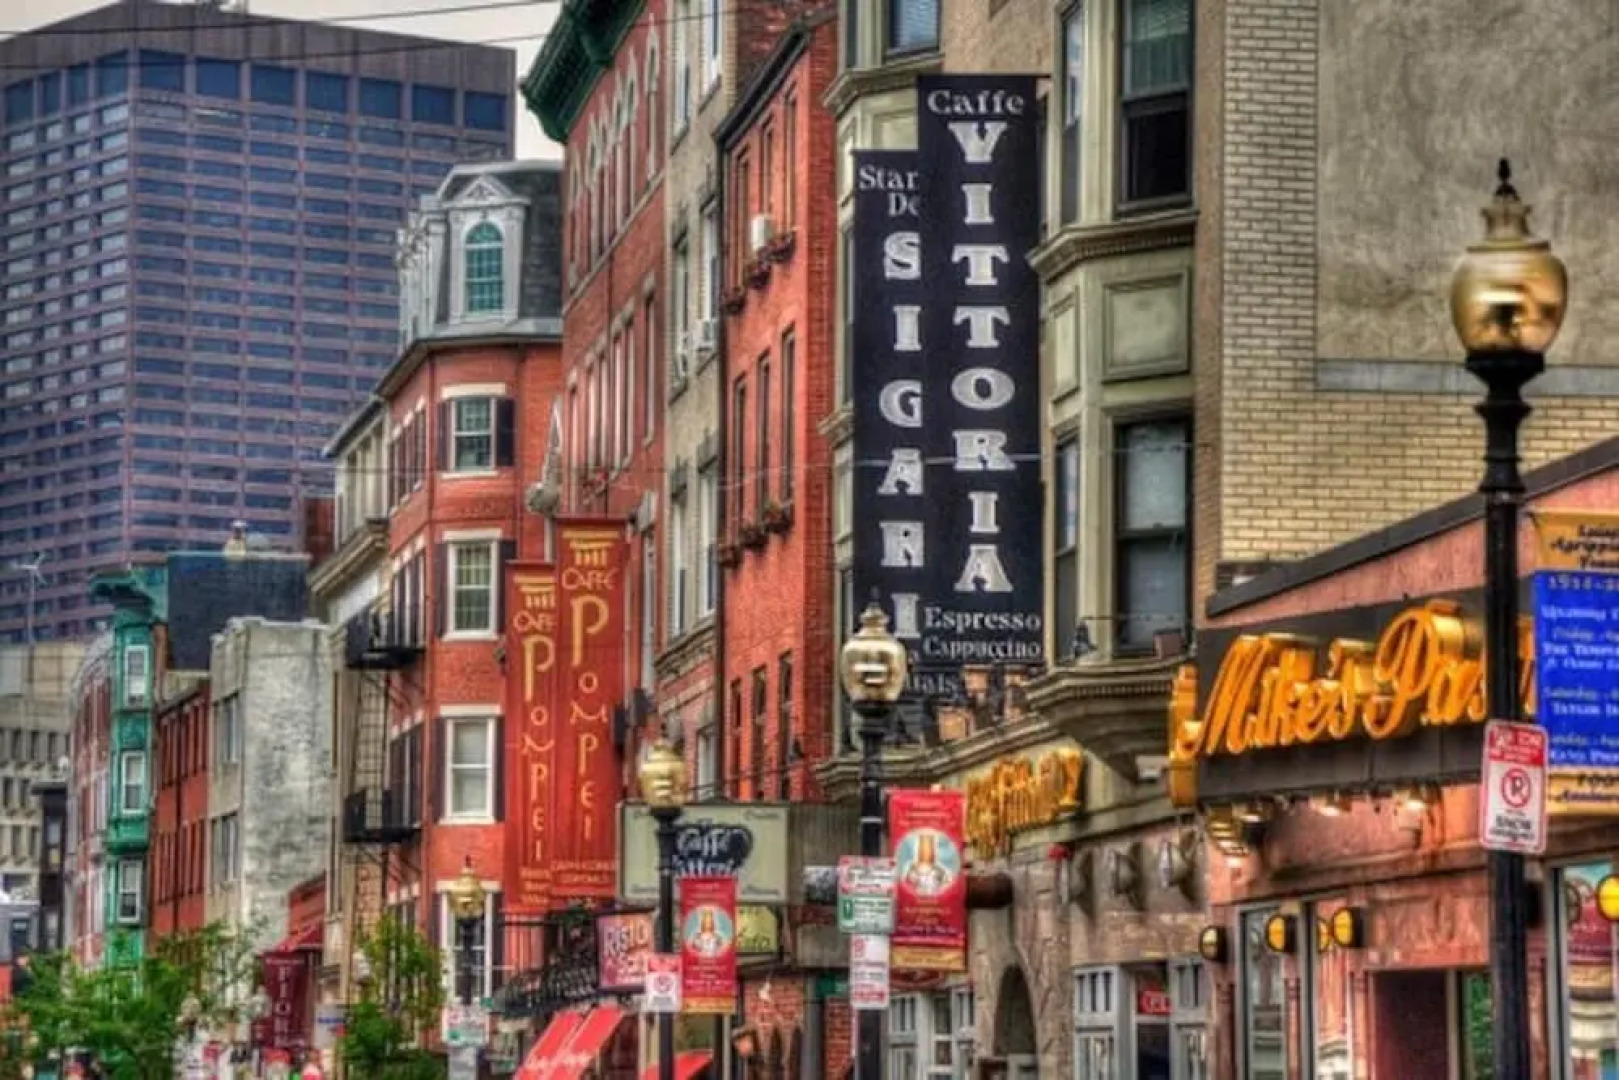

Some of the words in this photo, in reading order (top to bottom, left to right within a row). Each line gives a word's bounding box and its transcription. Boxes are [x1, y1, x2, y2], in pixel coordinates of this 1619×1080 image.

[927, 89, 1024, 116] Caffe
[947, 120, 1016, 593] VITTORIA
[877, 231, 924, 639] SIGARI
[923, 636, 1041, 660] Cappuccino
[924, 606, 1041, 634] Espresso
[570, 593, 609, 840] POMPEI
[1201, 633, 1357, 755] Mike's
